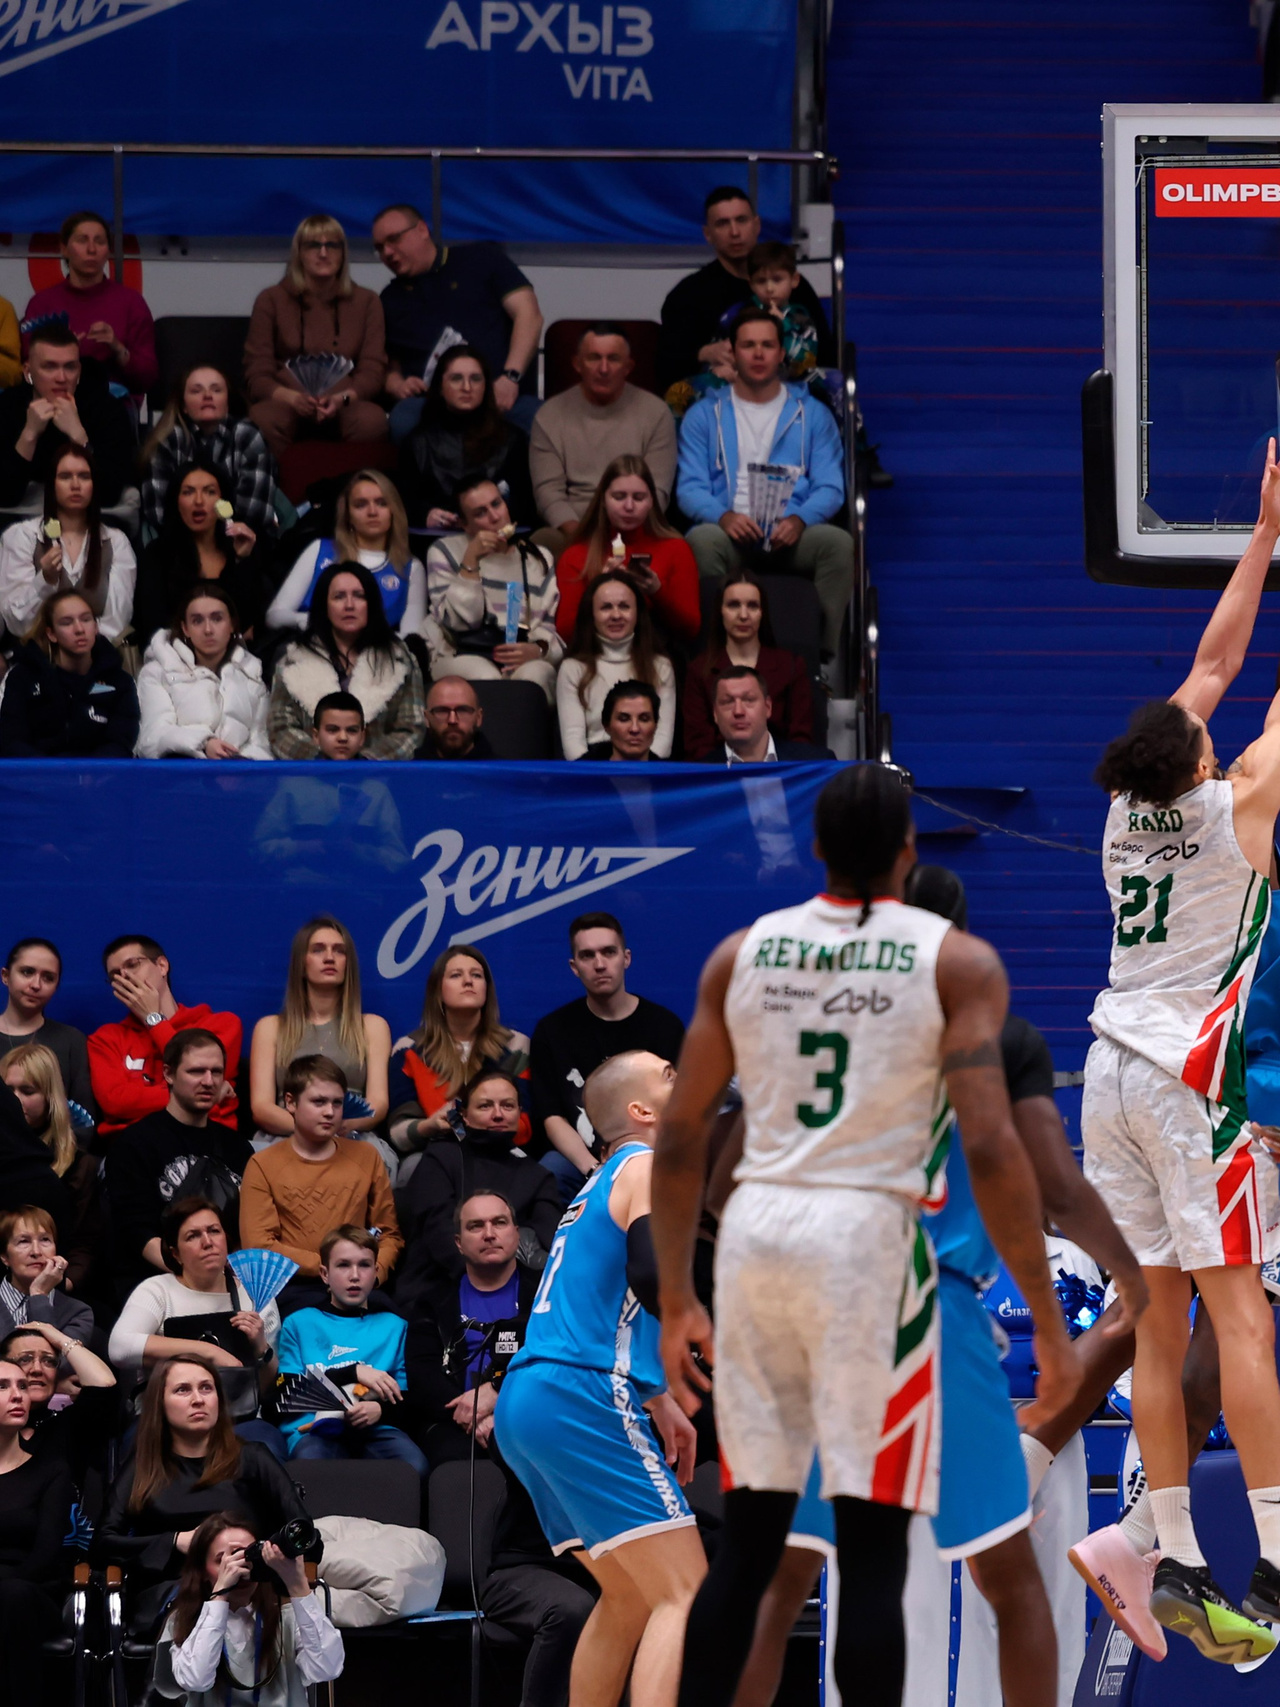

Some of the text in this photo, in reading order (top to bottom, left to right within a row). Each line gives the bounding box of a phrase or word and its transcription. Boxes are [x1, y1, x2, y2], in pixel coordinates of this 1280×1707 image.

[425, 1, 654, 57] АРХЫЗ
[562, 63, 653, 101] VITA
[376, 828, 697, 980] Зенит
[1116, 873, 1174, 947] 21
[754, 937, 917, 973] REYNOLDS
[797, 1031, 850, 1129] 3
